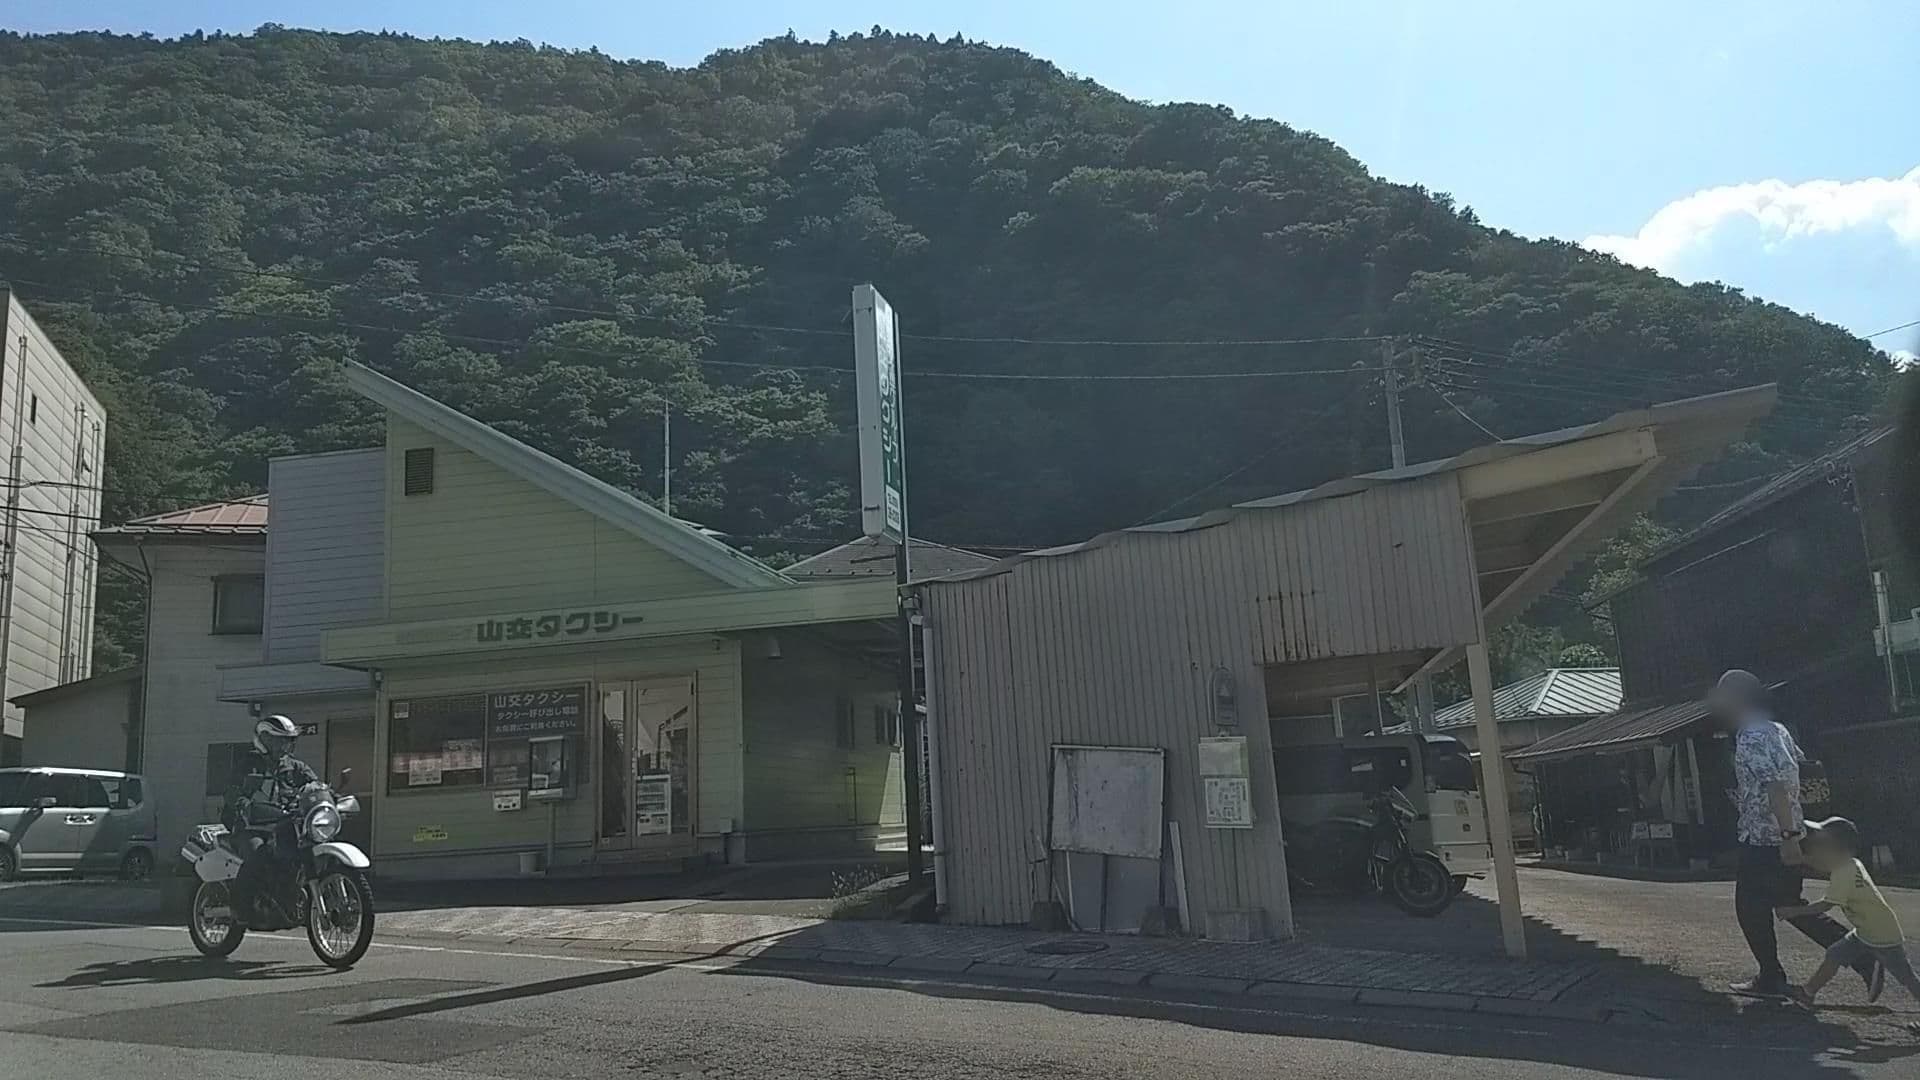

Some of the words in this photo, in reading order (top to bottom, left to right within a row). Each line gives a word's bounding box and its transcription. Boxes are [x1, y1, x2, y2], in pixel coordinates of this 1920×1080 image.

[477, 611, 644, 642] 山交タクシー
[495, 691, 580, 708] 山交タクシー
